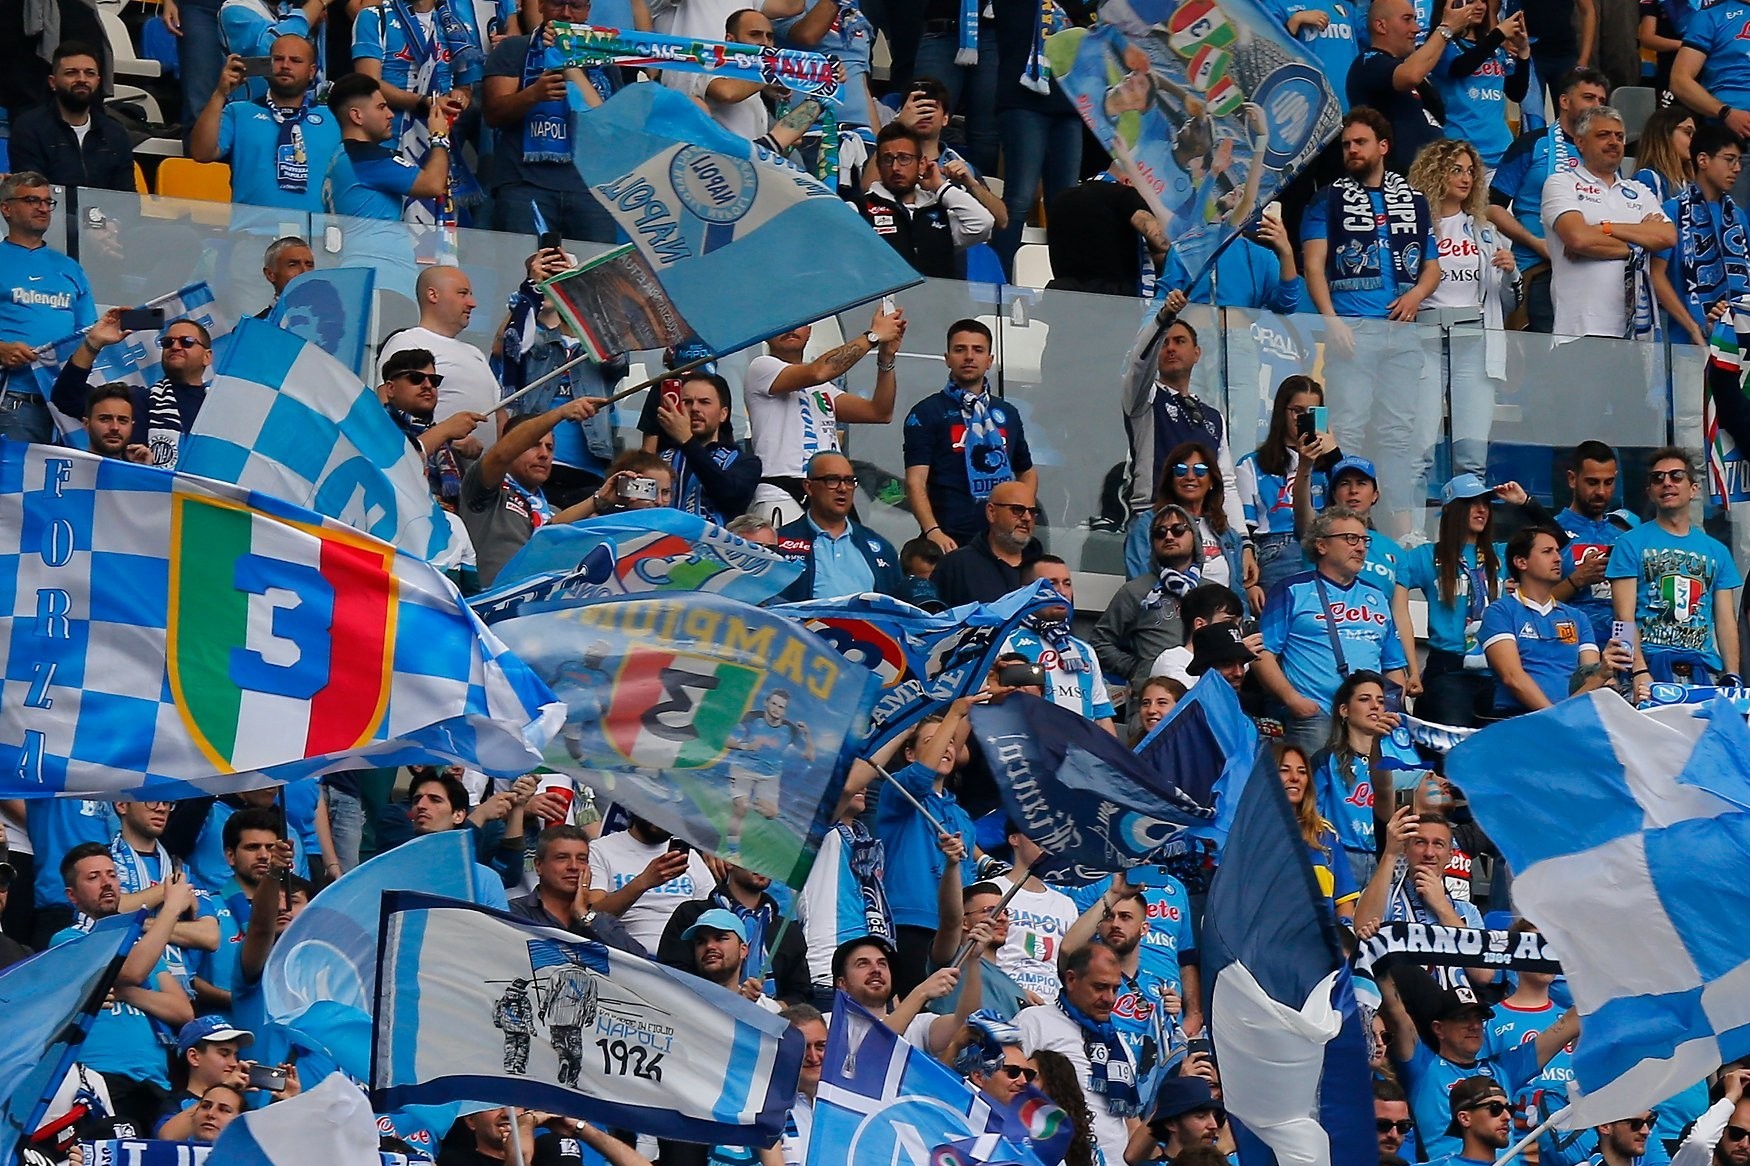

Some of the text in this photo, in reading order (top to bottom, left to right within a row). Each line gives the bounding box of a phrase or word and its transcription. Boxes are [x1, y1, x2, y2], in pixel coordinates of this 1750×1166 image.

[529, 119, 567, 140] NAPOLI
[11, 287, 71, 309] Polenghi
[16, 456, 75, 785] FORZA
[227, 552, 336, 701] 3
[1146, 899, 1183, 921] ete
[1146, 931, 1177, 949] MSC
[595, 1015, 672, 1054] NAPOLI
[1493, 1021, 1514, 1037] EA7
[596, 1039, 663, 1084] 1926
[1114, 1057, 1129, 1080] 19
[1541, 1067, 1573, 1083] MSC
